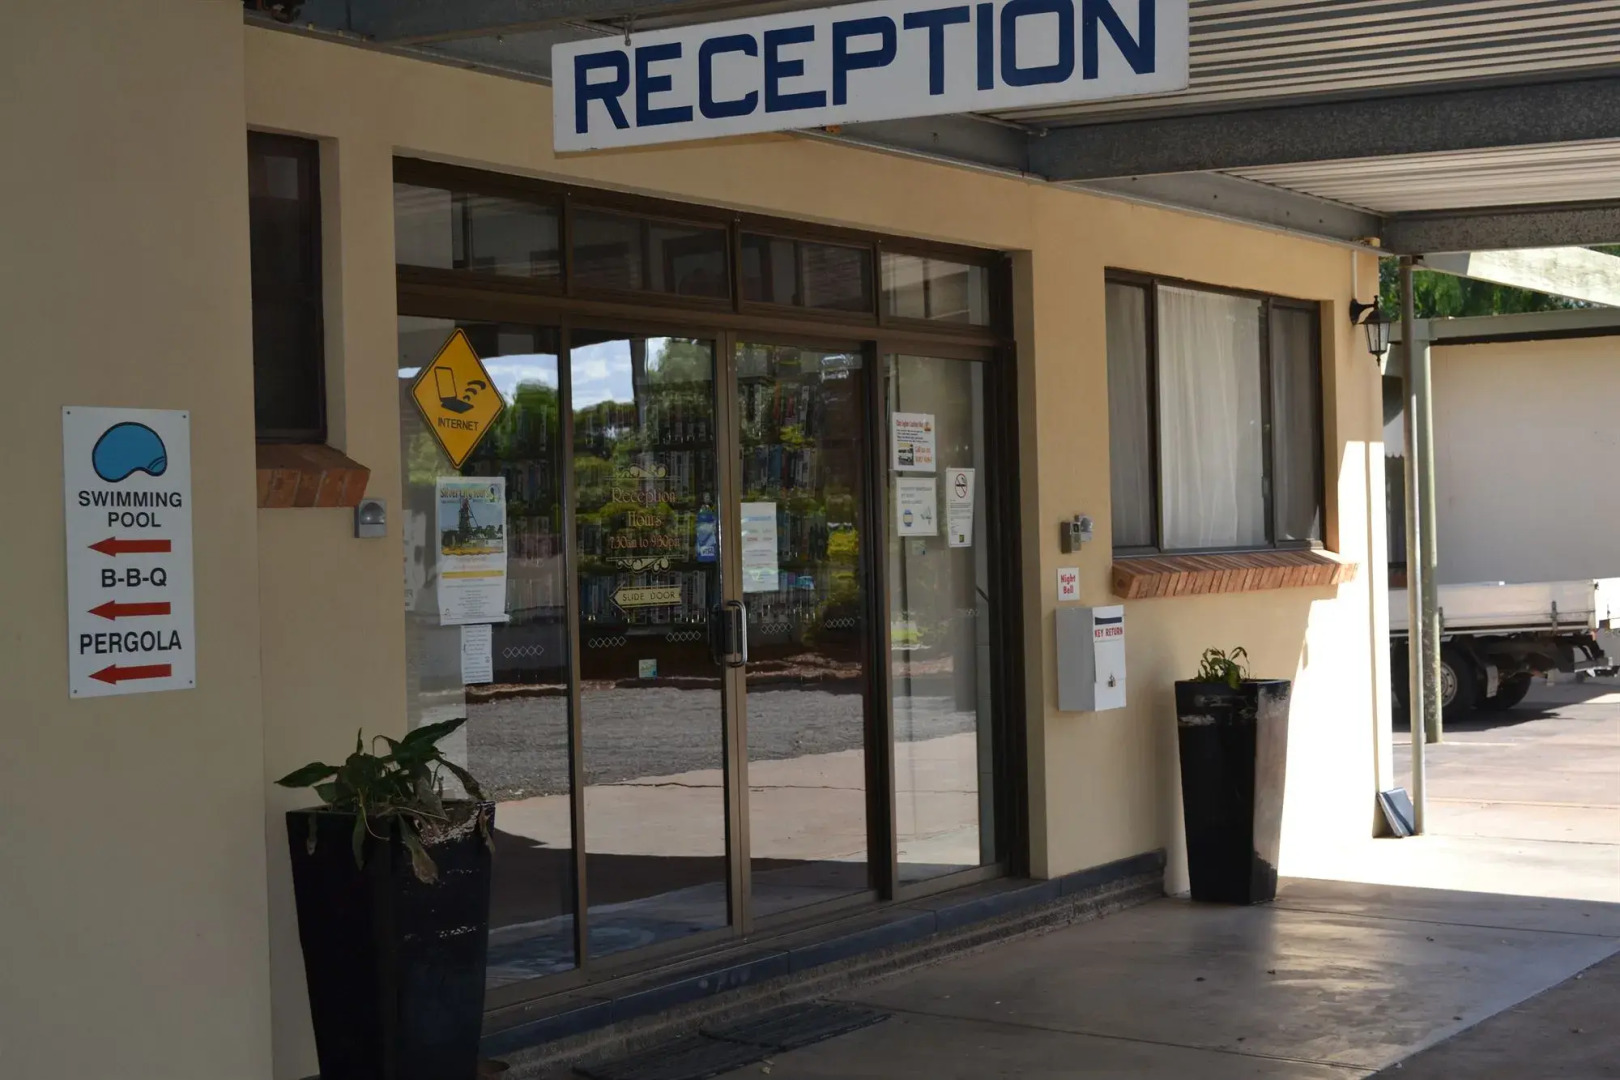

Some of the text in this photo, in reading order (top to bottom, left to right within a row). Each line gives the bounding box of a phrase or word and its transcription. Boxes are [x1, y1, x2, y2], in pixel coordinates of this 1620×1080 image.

[574, 0, 1156, 135] RECEPTION
[437, 417, 479, 431] INTERNET
[78, 490, 183, 508] SWIMMING
[611, 486, 677, 508] Reception
[107, 512, 162, 528] POOL
[627, 510, 663, 527] Hours
[639, 536, 649, 548] to
[101, 567, 167, 587] B-B-Q
[1061, 574, 1076, 585] Night
[622, 591, 676, 602] SLIDE DOOR
[1063, 585, 1074, 594] Bell
[1094, 626, 1123, 638] KEY RETURN
[80, 630, 182, 655] PERGOLA
